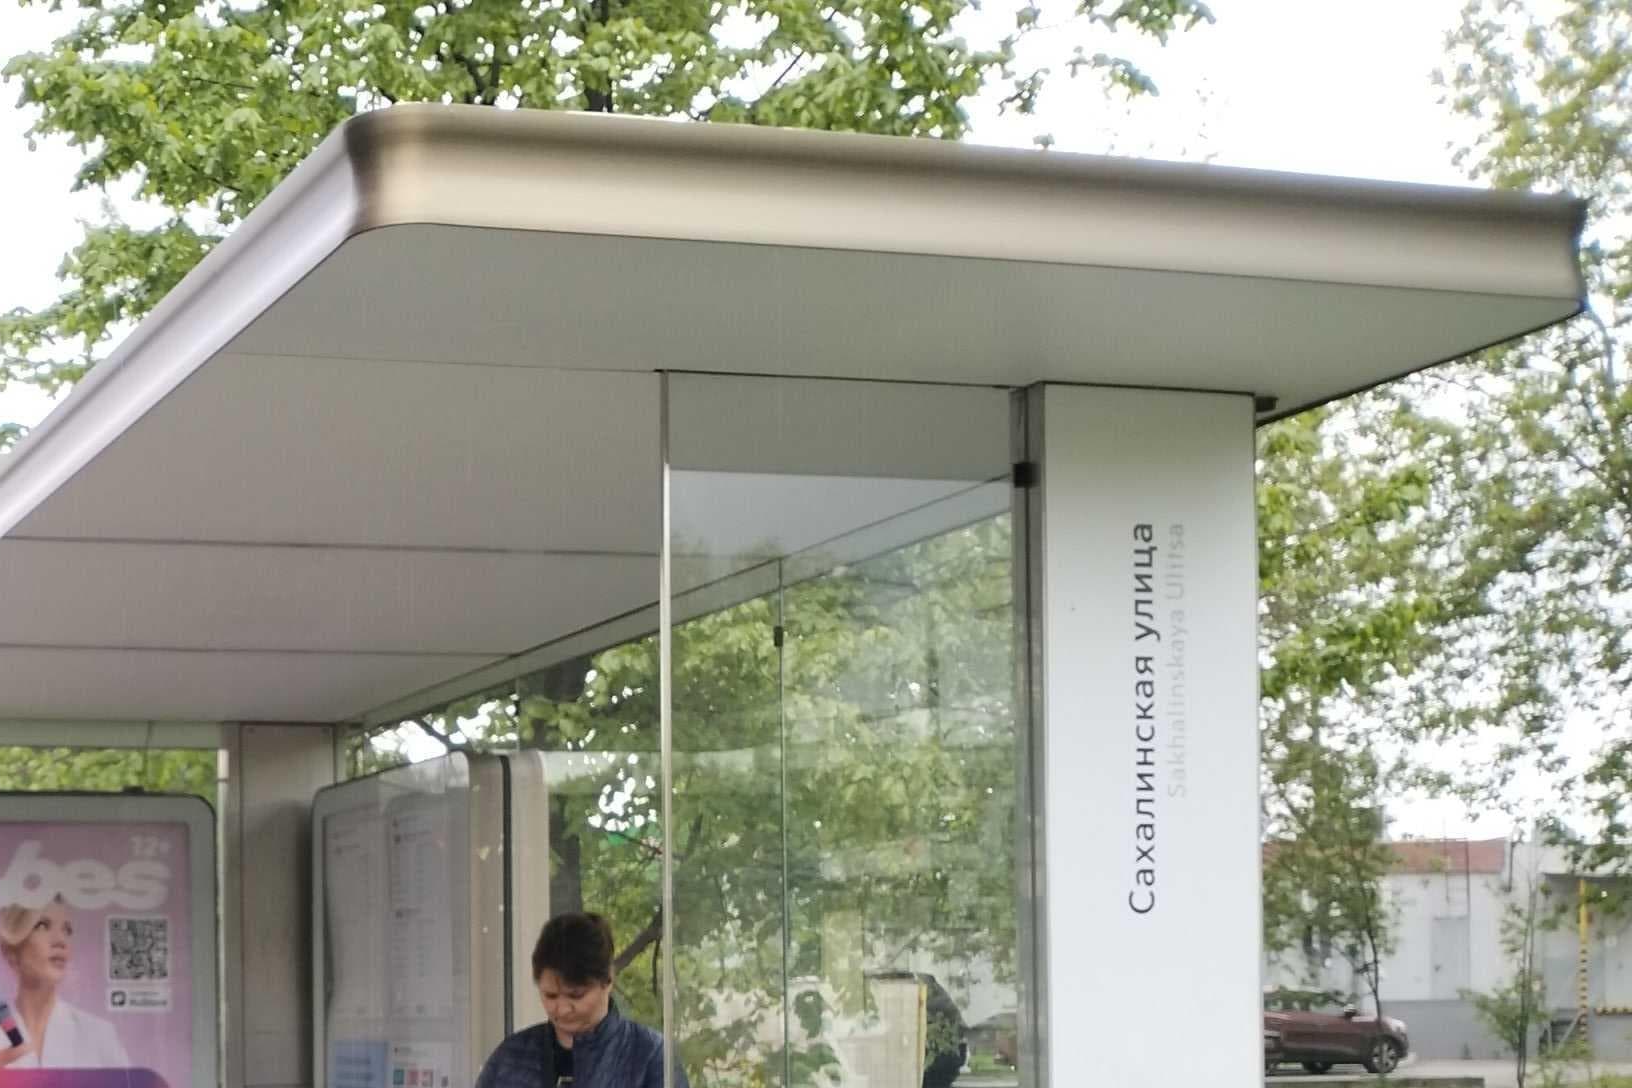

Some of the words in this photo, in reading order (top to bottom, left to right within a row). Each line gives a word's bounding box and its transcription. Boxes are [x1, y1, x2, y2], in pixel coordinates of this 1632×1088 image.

[1133, 522, 1161, 642] улица
[1166, 522, 1186, 601] Ulitsa
[1166, 608, 1189, 799] Sakhalinskaya
[1128, 655, 1156, 915] Сахалинская
